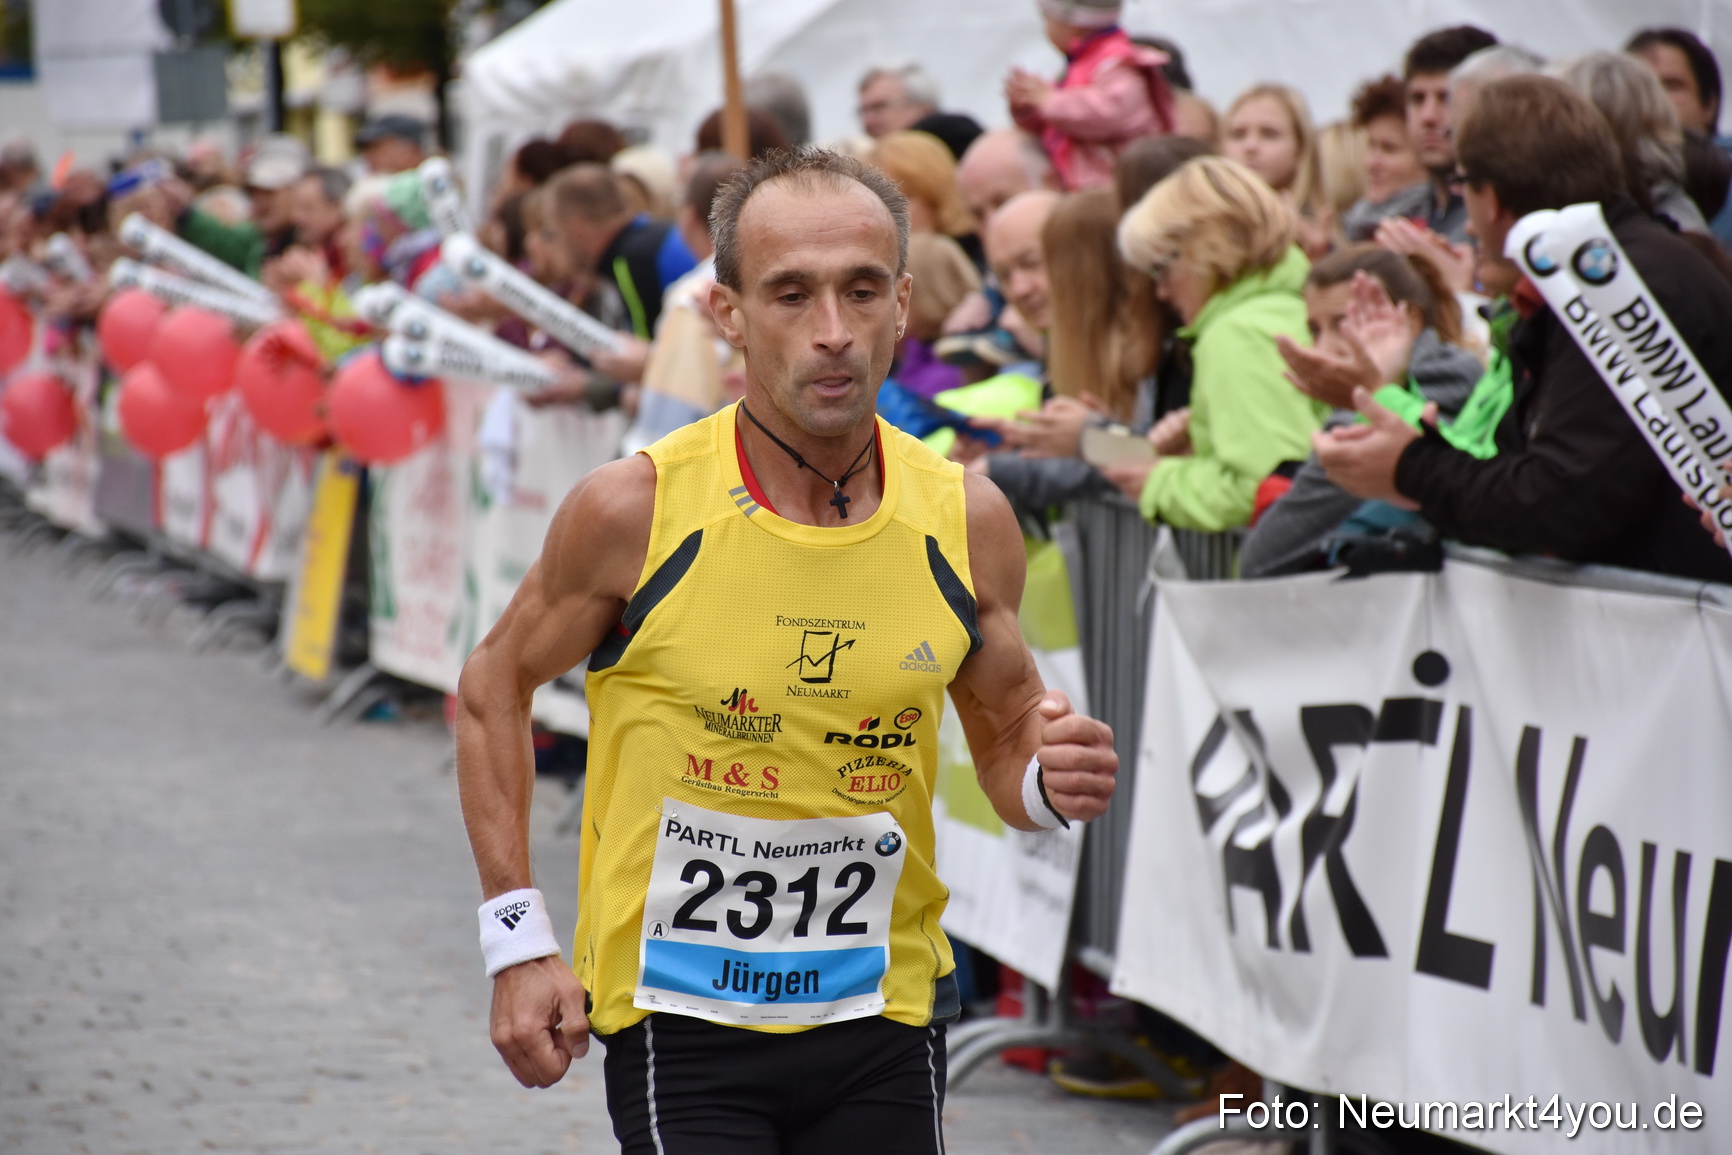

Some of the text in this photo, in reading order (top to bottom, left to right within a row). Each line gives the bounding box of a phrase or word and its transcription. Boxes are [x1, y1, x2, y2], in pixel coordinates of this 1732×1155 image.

[1611, 296, 1696, 393] BMW
[776, 615, 866, 630] FONDSZENTRUM
[899, 659, 942, 673] adidas
[786, 684, 852, 699] NEUMARKT
[693, 704, 783, 733] NEUMARKTER
[704, 720, 774, 743] MINERALBRUNNEN
[684, 752, 780, 791] M & S
[836, 756, 913, 779] PIZZERIA
[848, 773, 902, 793] ELIO
[665, 819, 865, 860] PARTL Neumarkt
[494, 900, 531, 919] adidas
[672, 859, 876, 940] 2312
[653, 923, 663, 937] A
[712, 959, 820, 1002] Jürgen
